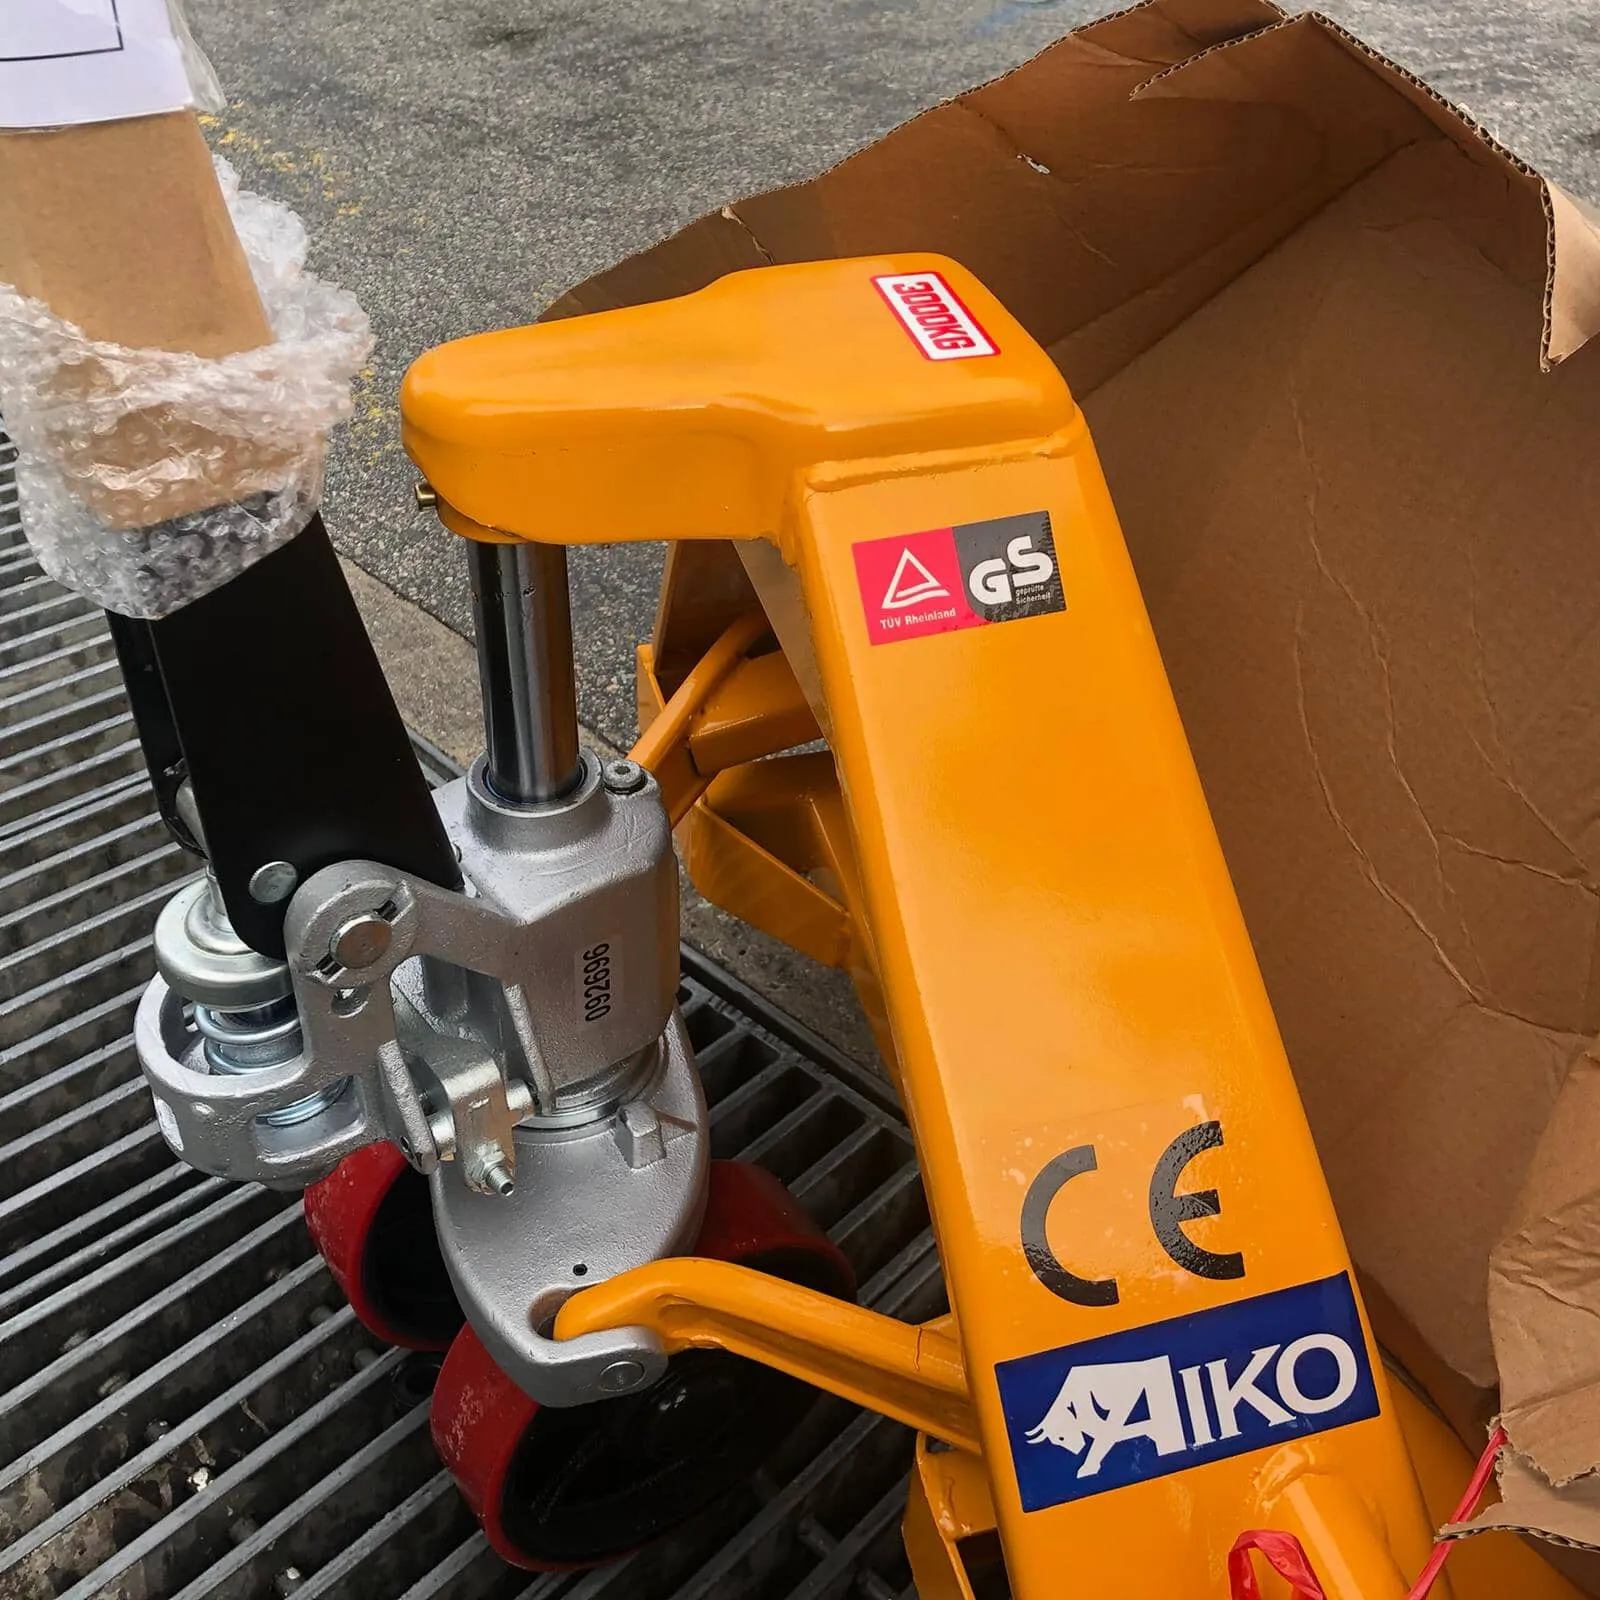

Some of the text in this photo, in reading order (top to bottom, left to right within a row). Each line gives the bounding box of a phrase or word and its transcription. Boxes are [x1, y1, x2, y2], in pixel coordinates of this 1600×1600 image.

[892, 281, 976, 350] 3000KG
[968, 535, 1054, 605] GS
[880, 608, 957, 629] TÜV Rheinland
[583, 943, 611, 1021] 092696
[1020, 1120, 1246, 1307] CE
[1030, 1333, 1358, 1478] AIKO
